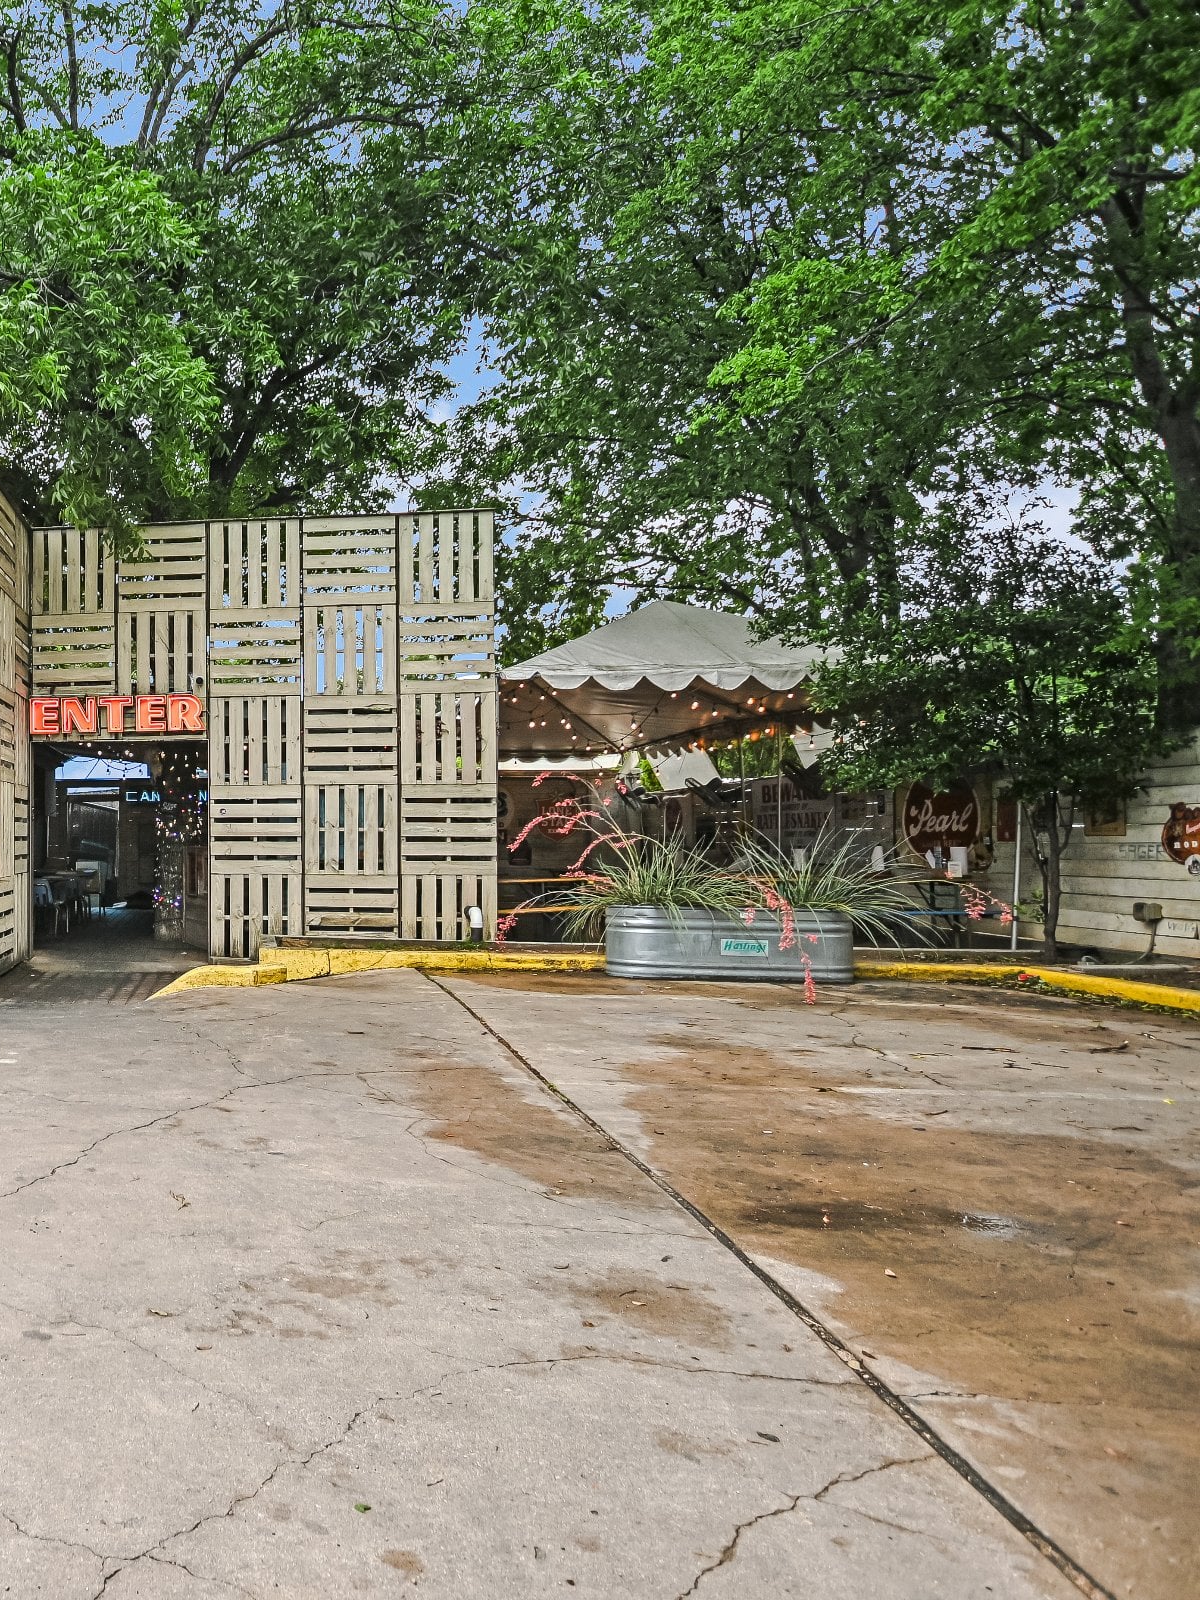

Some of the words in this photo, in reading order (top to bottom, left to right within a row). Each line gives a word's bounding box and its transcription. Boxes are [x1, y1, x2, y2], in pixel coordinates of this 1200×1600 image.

[29, 694, 206, 735] ENTER
[909, 799, 973, 837] Pearl
[723, 940, 767, 954] Hastings
